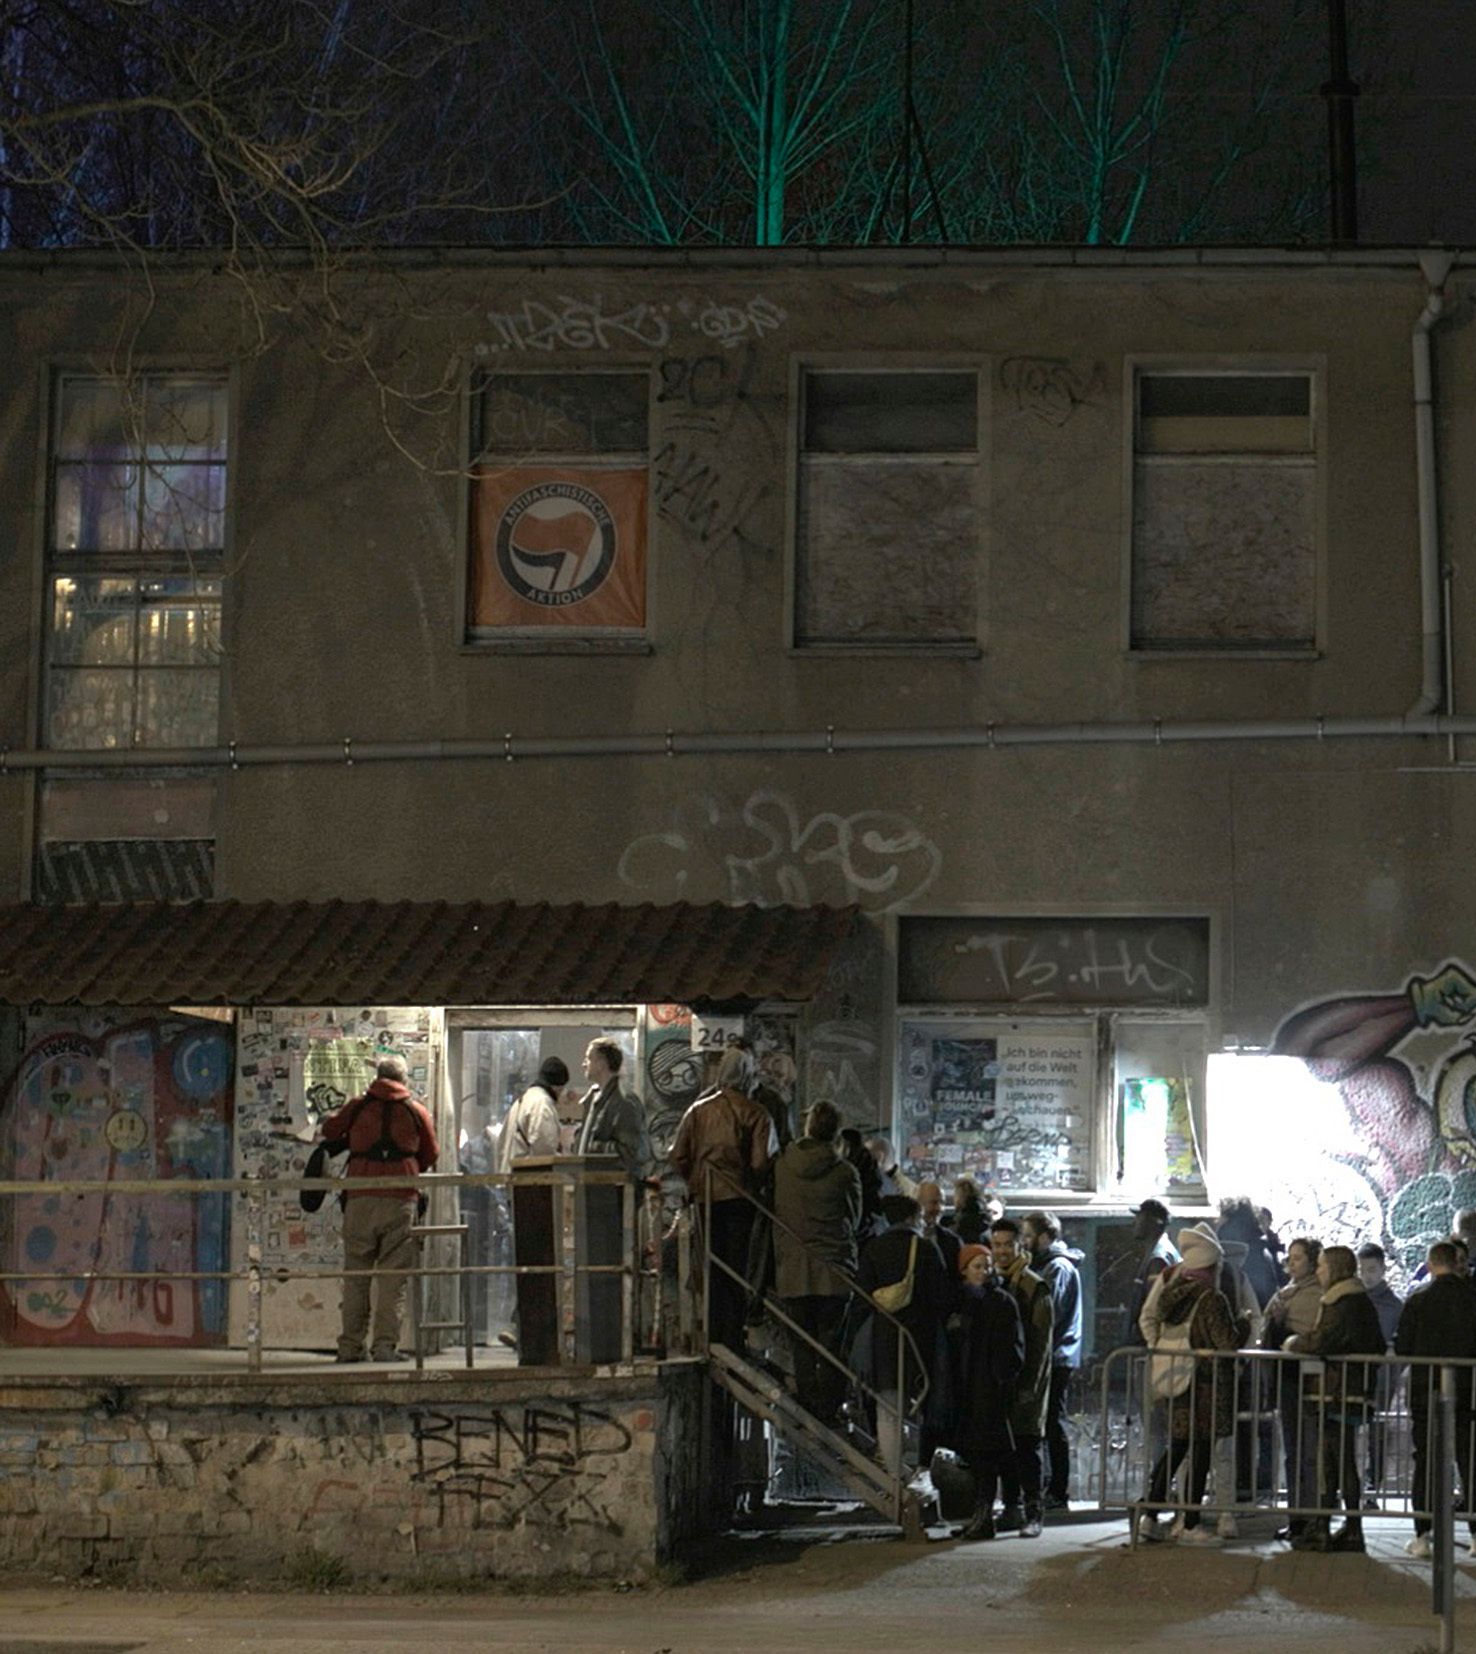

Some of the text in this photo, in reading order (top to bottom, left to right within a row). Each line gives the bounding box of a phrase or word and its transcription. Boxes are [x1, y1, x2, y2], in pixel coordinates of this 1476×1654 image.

[504, 485, 610, 527] ANTIFASCHISTISCHE
[527, 589, 584, 605] AKTION
[1051, 1047, 1082, 1058] nicht
[1006, 1062, 1078, 1073] auf die Welt
[936, 1090, 992, 1102] FEMALE
